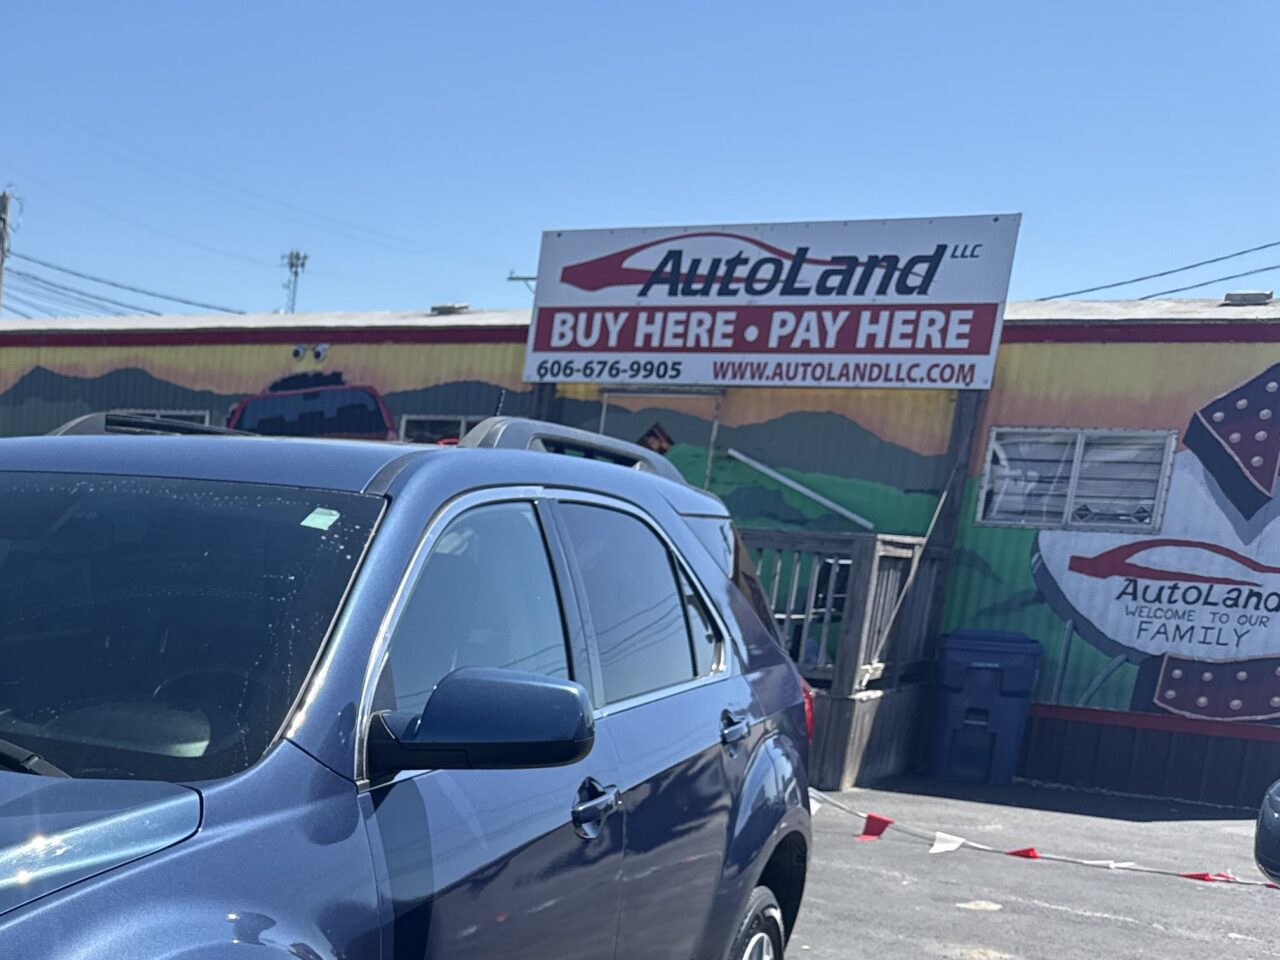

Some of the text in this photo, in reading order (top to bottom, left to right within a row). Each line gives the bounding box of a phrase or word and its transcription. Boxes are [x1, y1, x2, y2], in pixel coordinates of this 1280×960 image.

[637, 243, 983, 297] AutoLand LLC
[550, 309, 974, 349] BUY HERE PAY HERE
[536, 360, 977, 384] 606-676-9905 WWW.AUTOLANDLLC.COM
[1125, 604, 1270, 628] WELCOME TO OUR
[1136, 620, 1251, 648] FAMILY
